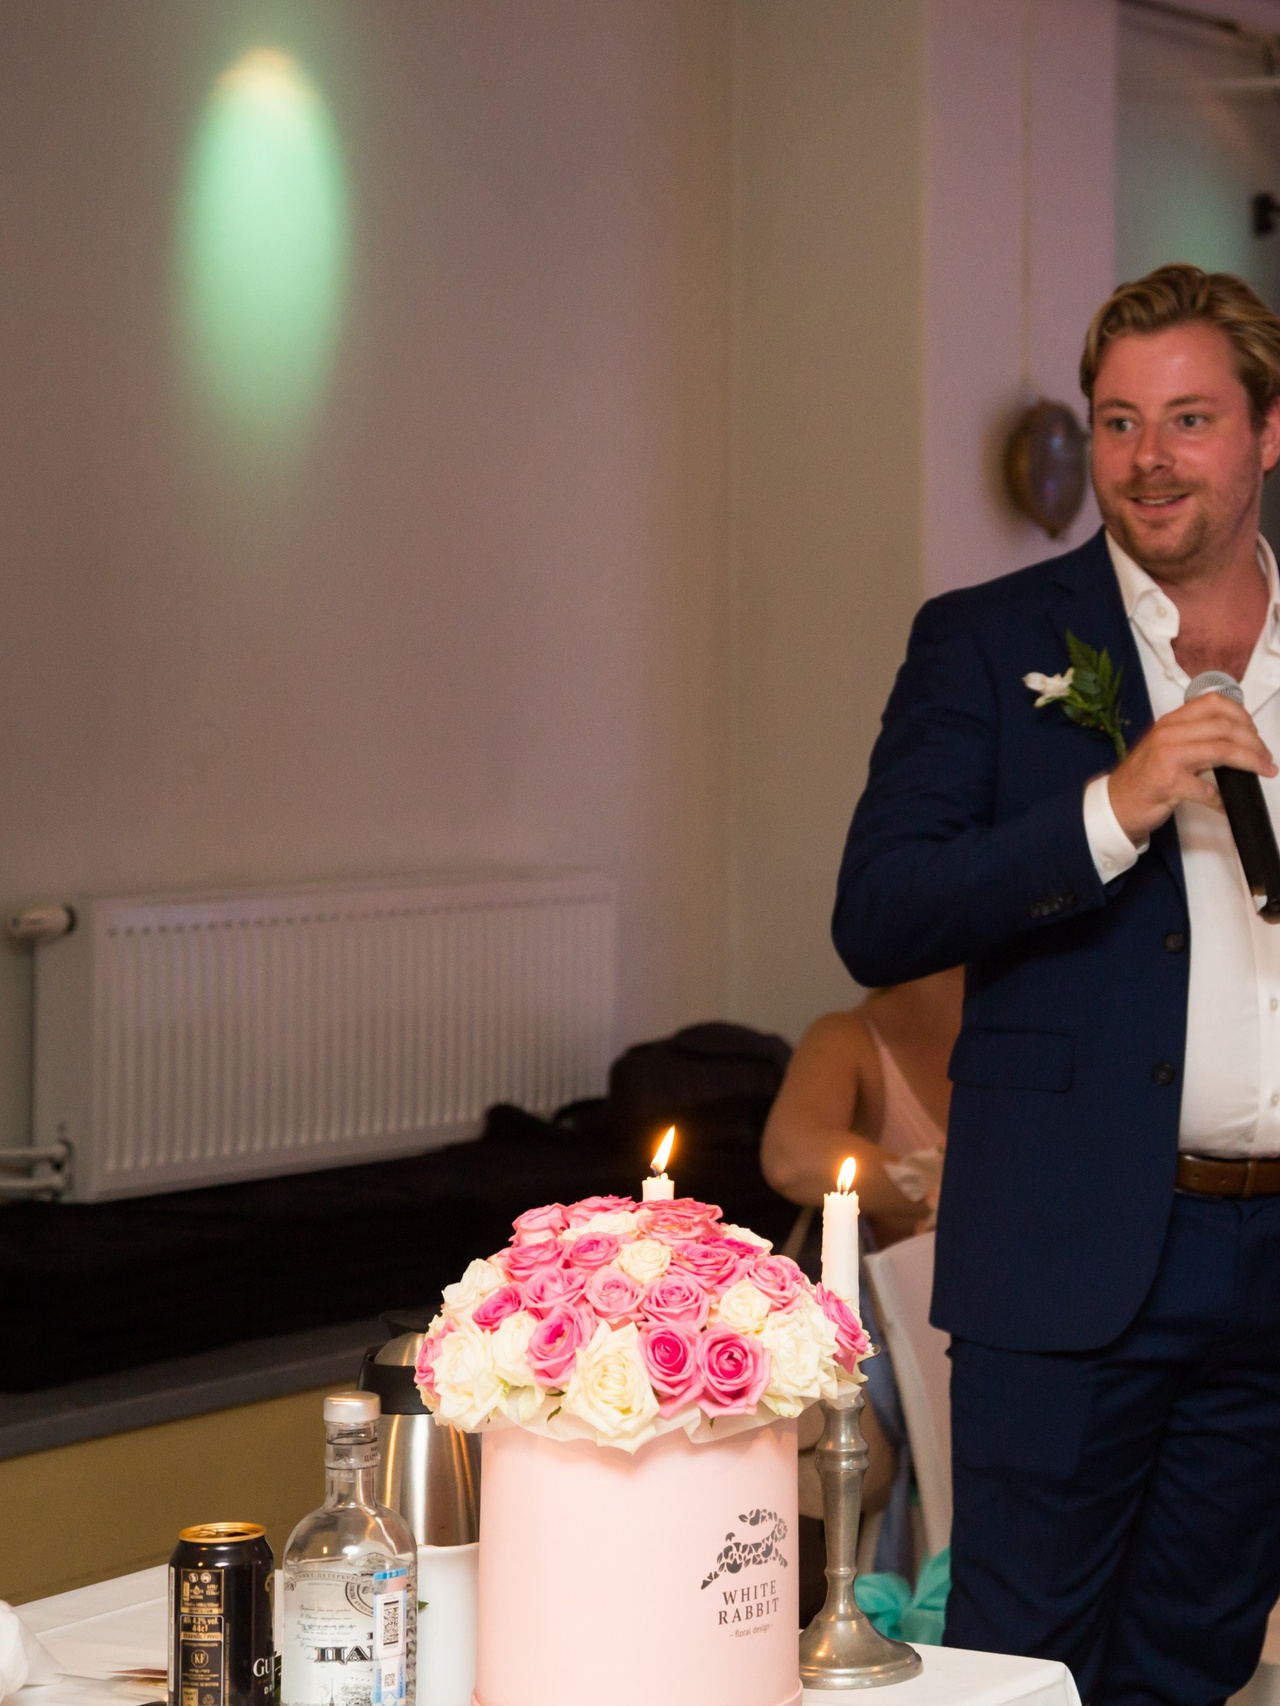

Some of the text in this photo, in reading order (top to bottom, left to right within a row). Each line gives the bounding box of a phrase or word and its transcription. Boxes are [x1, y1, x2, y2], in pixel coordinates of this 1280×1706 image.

[722, 1580, 776, 1606] WHITE
[718, 1597, 779, 1625] RABBIT
[735, 1623, 770, 1638] floral design
[253, 1657, 274, 1678] GU
